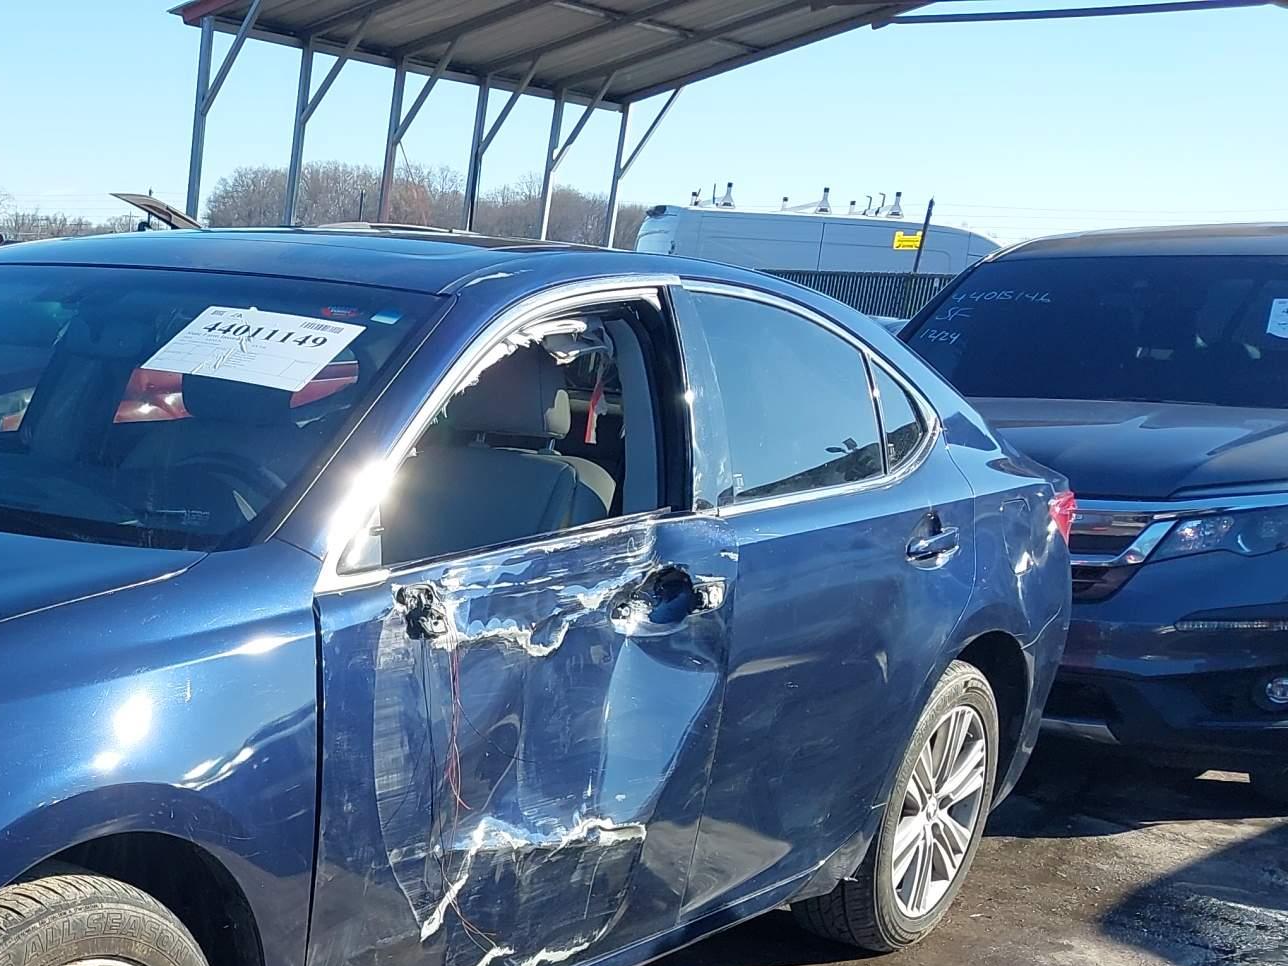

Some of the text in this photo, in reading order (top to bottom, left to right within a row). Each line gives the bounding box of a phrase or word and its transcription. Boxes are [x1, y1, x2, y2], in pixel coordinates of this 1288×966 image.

[203, 321, 328, 348] 44011149
[920, 329, 961, 345] 12/24
[23, 919, 77, 966] ALL
[85, 911, 190, 965] SEASON
